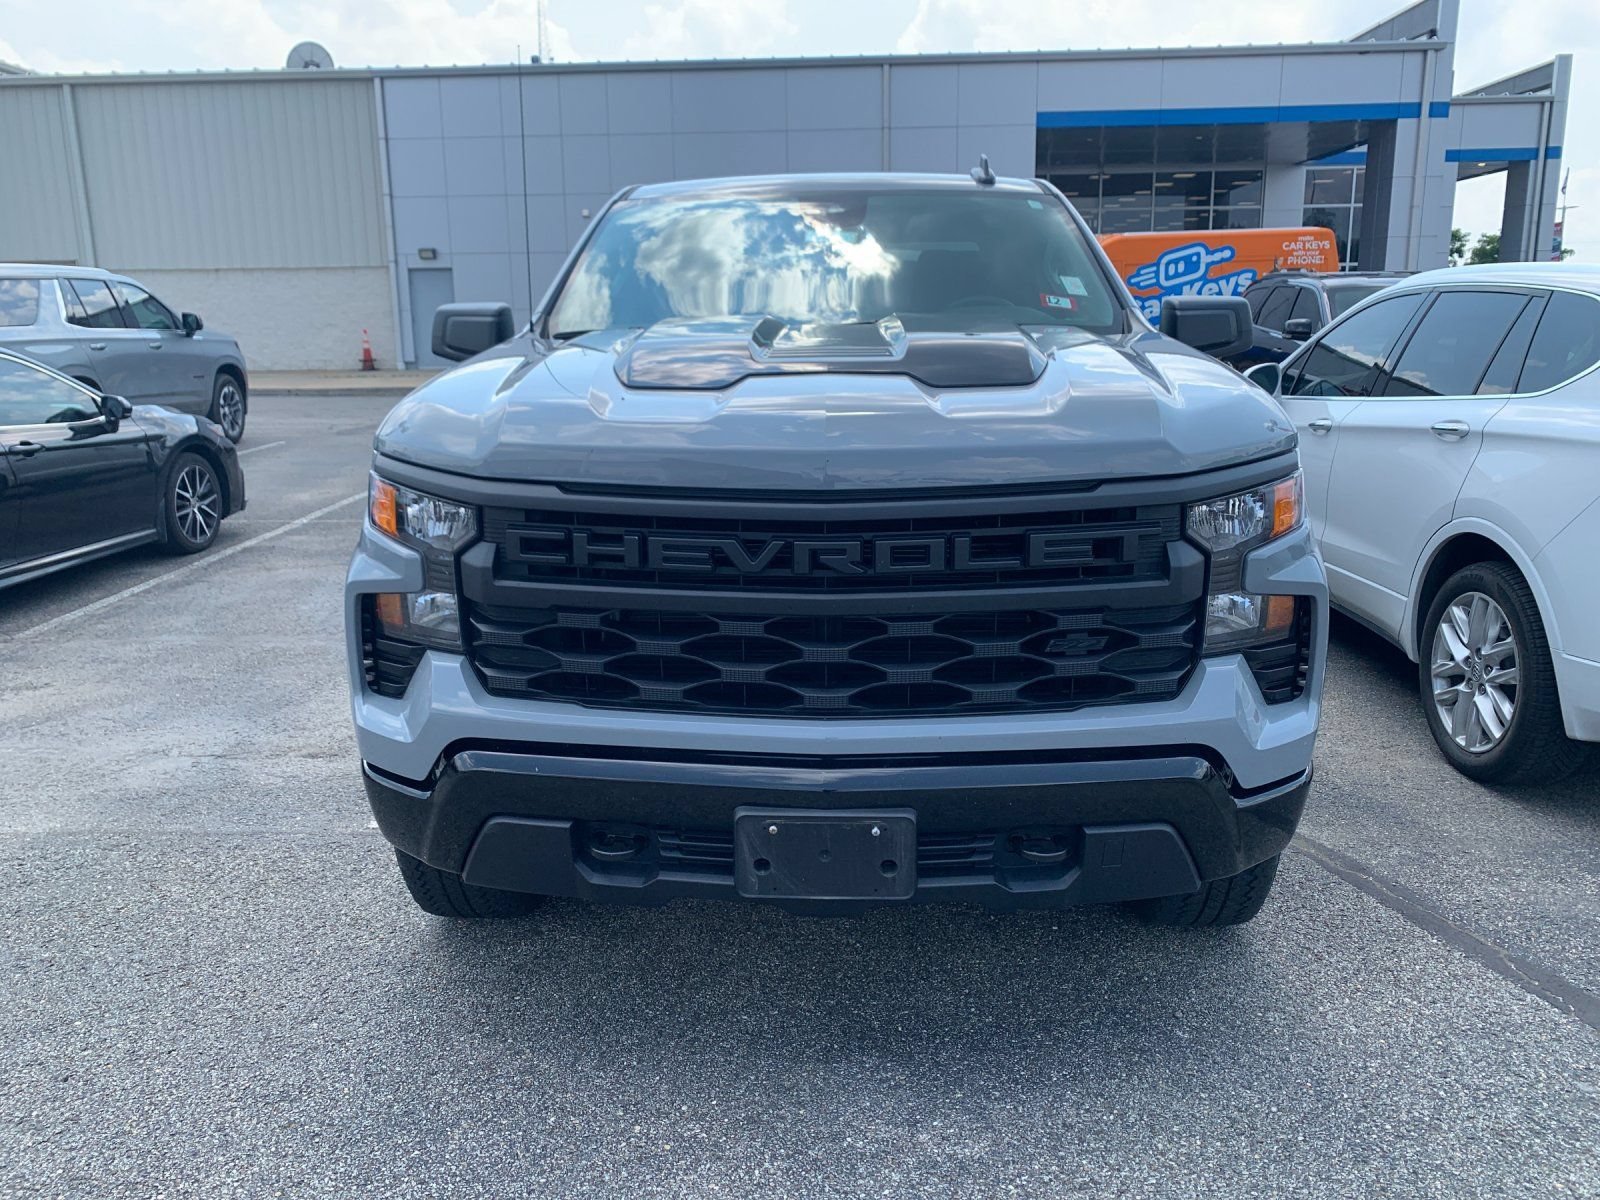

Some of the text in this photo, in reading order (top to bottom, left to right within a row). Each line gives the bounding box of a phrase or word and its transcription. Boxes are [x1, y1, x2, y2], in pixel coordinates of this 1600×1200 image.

[1282, 240, 1330, 250] CAR KEYS
[1287, 256, 1324, 265] PHONE!
[504, 523, 1163, 575] CHEVROLET
